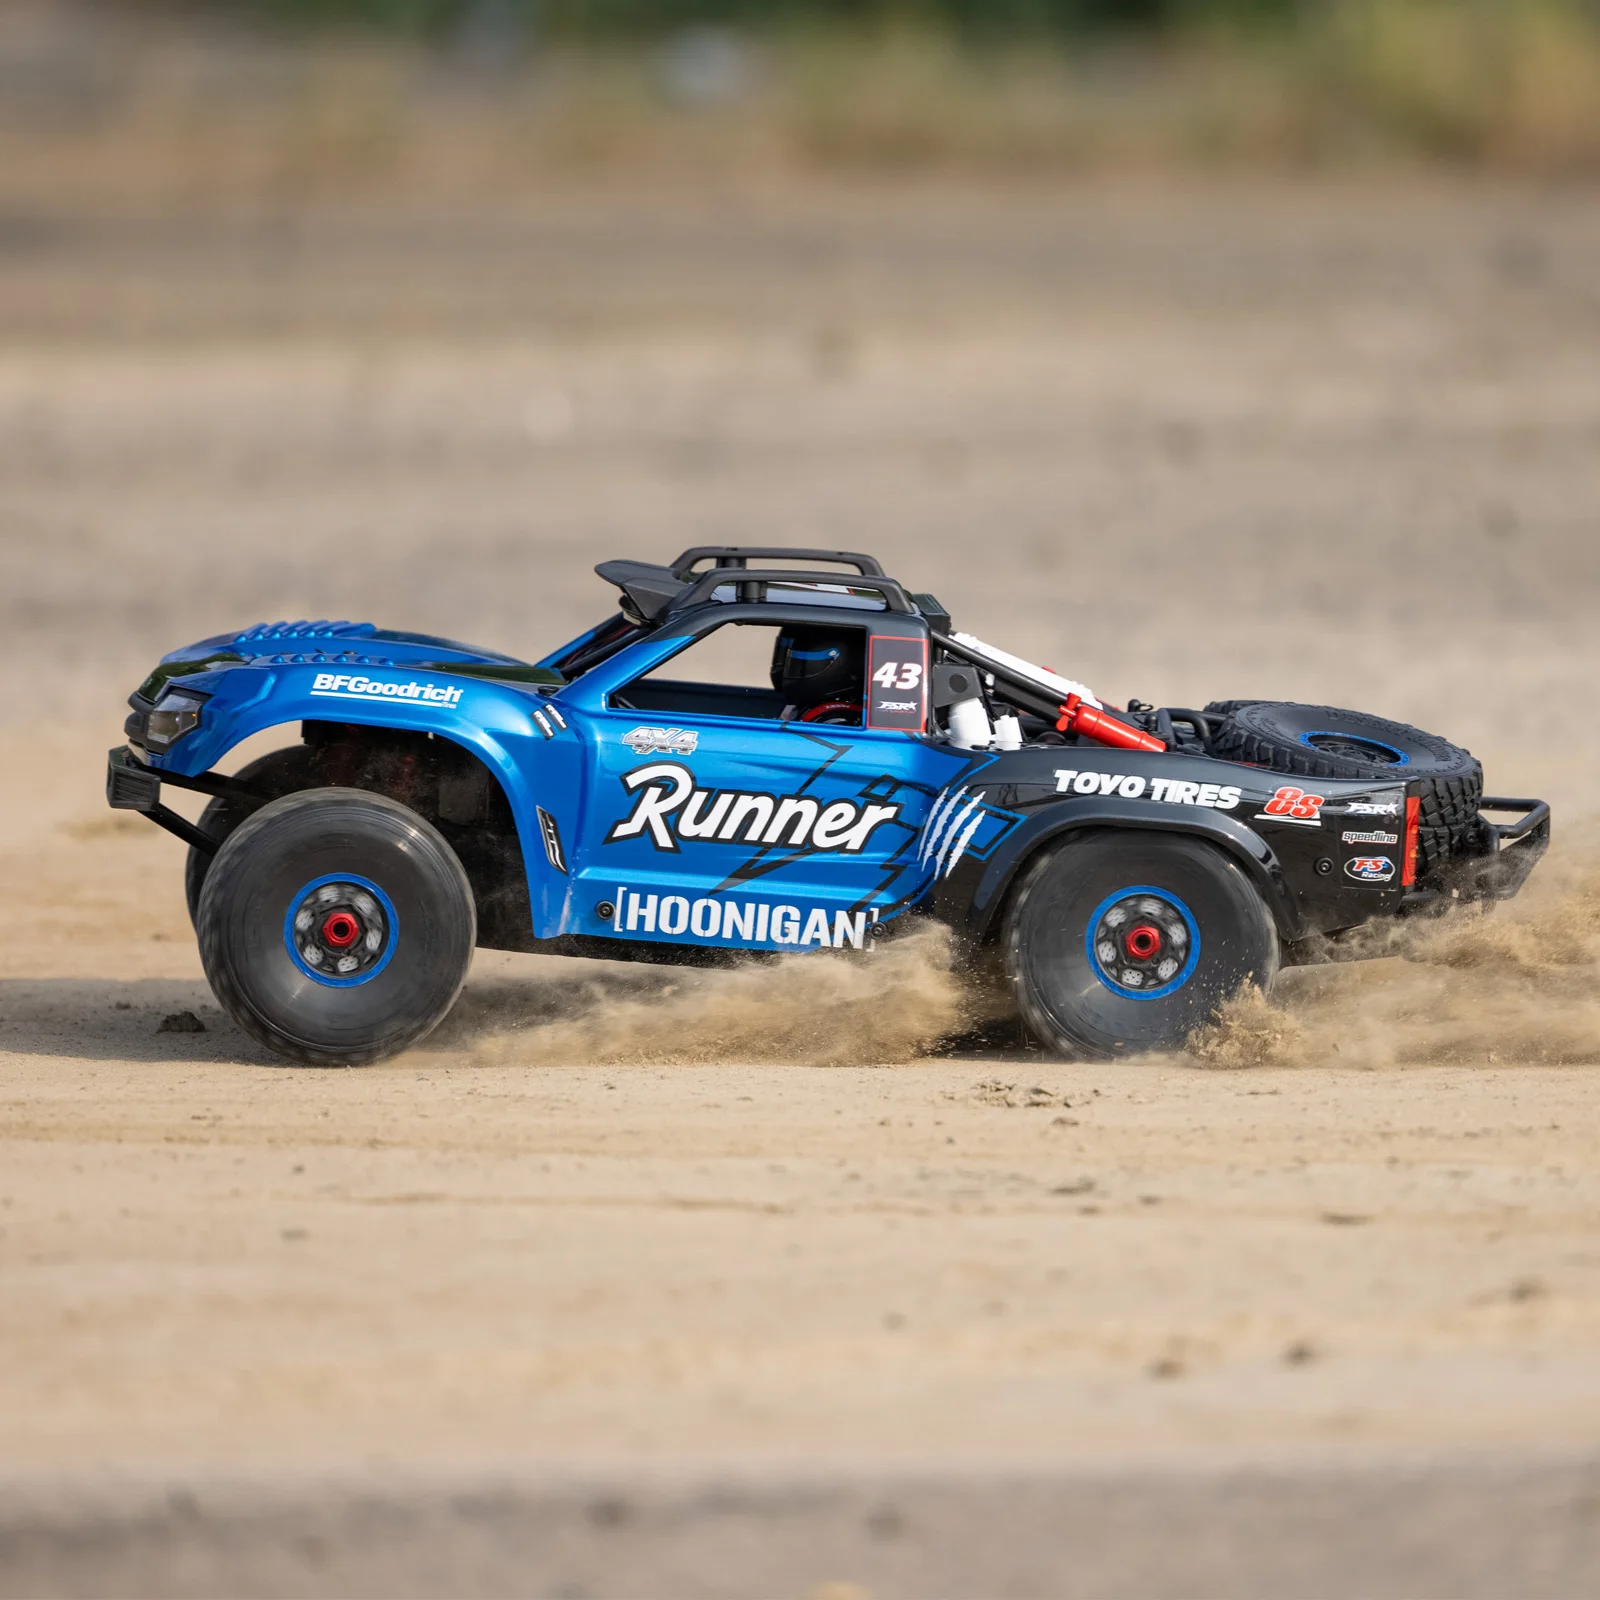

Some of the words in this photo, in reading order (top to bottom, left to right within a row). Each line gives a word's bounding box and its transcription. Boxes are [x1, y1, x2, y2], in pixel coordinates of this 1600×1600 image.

[312, 673, 463, 703] BFGoodrich
[872, 661, 923, 690] 43
[1054, 769, 1147, 798] TOYO
[1150, 778, 1242, 810] TIRES
[606, 761, 902, 853] Runner
[1342, 831, 1397, 844] speedline
[1352, 858, 1384, 871] FS
[1361, 871, 1391, 882] Racing
